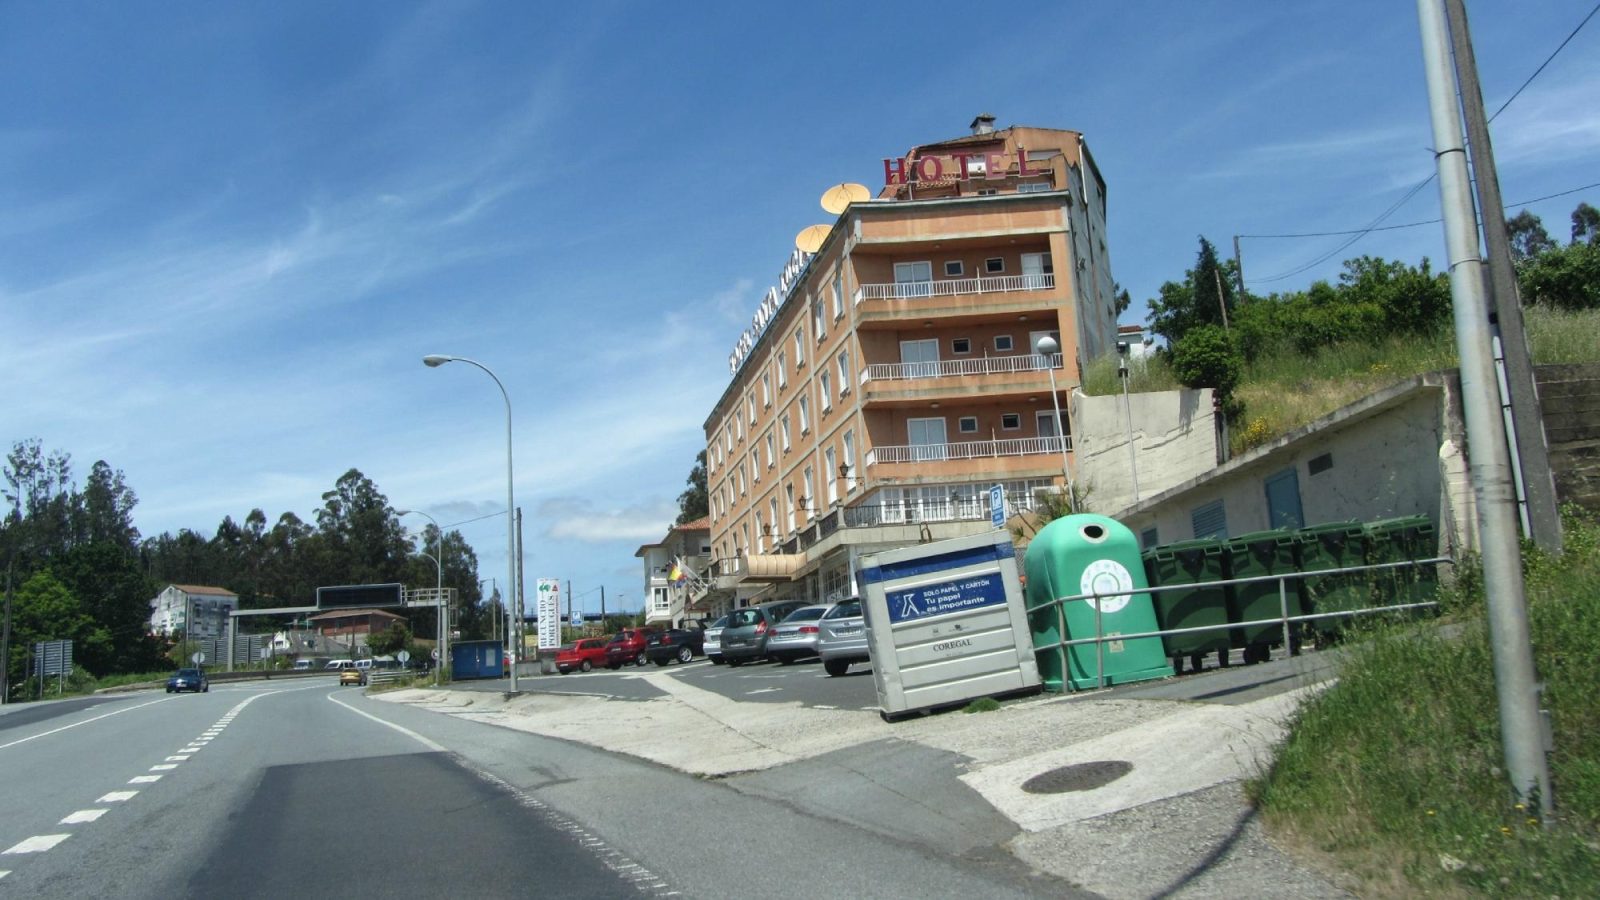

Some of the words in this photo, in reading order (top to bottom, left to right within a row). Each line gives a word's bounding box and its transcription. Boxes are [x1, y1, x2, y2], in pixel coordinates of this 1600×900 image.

[883, 149, 1040, 186] HOTEL
[941, 586, 959, 594] PAPEL
[938, 593, 961, 604] papel
[939, 597, 985, 610] importante
[933, 639, 972, 651] COREGAL
